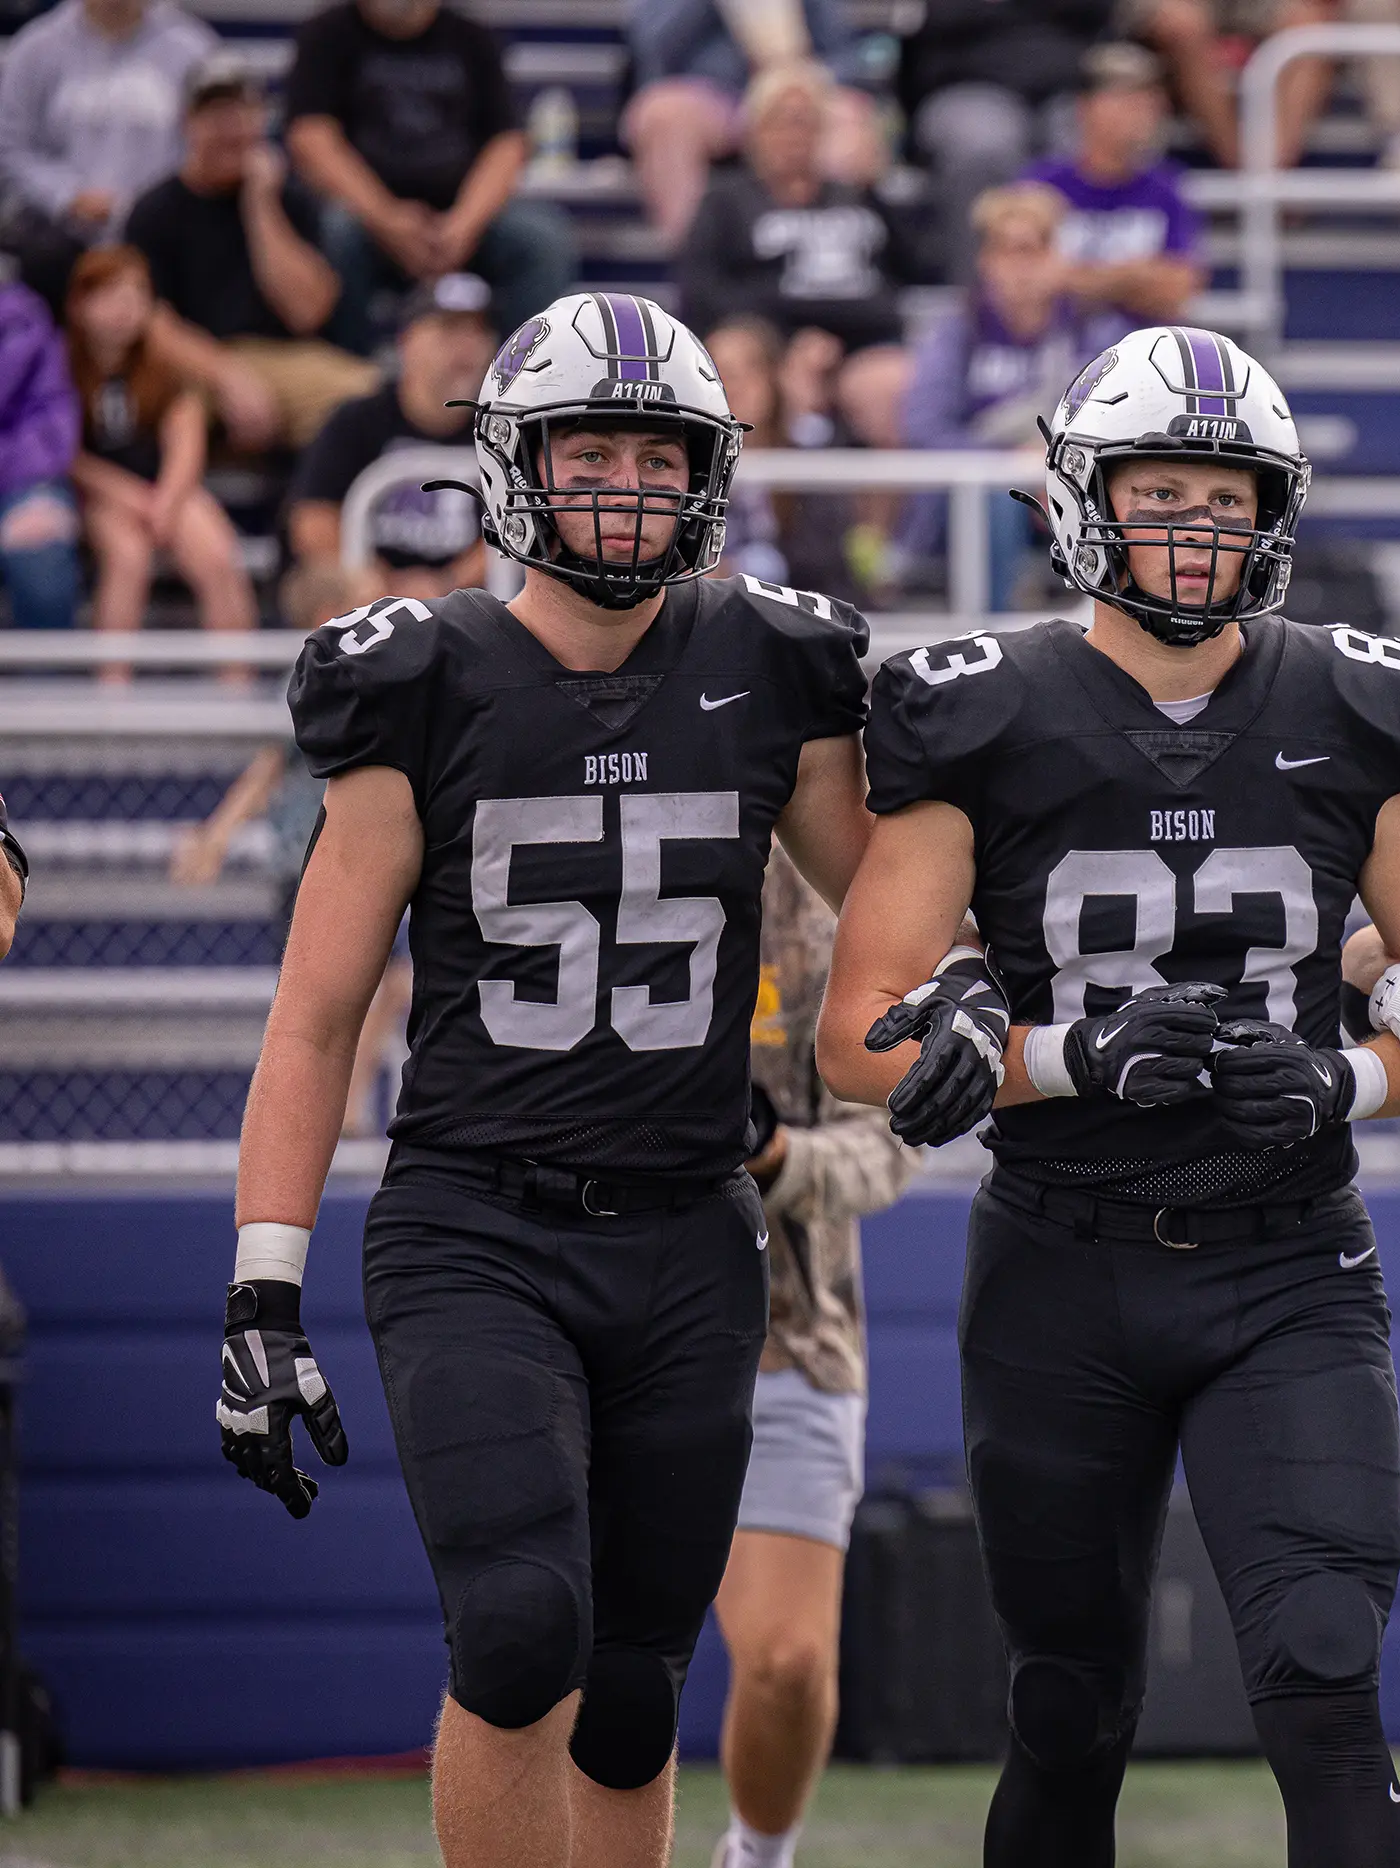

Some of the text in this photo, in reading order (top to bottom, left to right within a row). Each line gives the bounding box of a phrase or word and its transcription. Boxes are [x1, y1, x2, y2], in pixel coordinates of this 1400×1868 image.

[611, 382, 663, 401] A11IN
[1186, 419, 1237, 440] A11IN
[740, 572, 832, 620] 5
[907, 629, 1004, 686] 3
[583, 752, 649, 785] BISON
[1150, 809, 1216, 841] BISON
[470, 790, 741, 1052] 55
[1043, 845, 1320, 1036] 83
